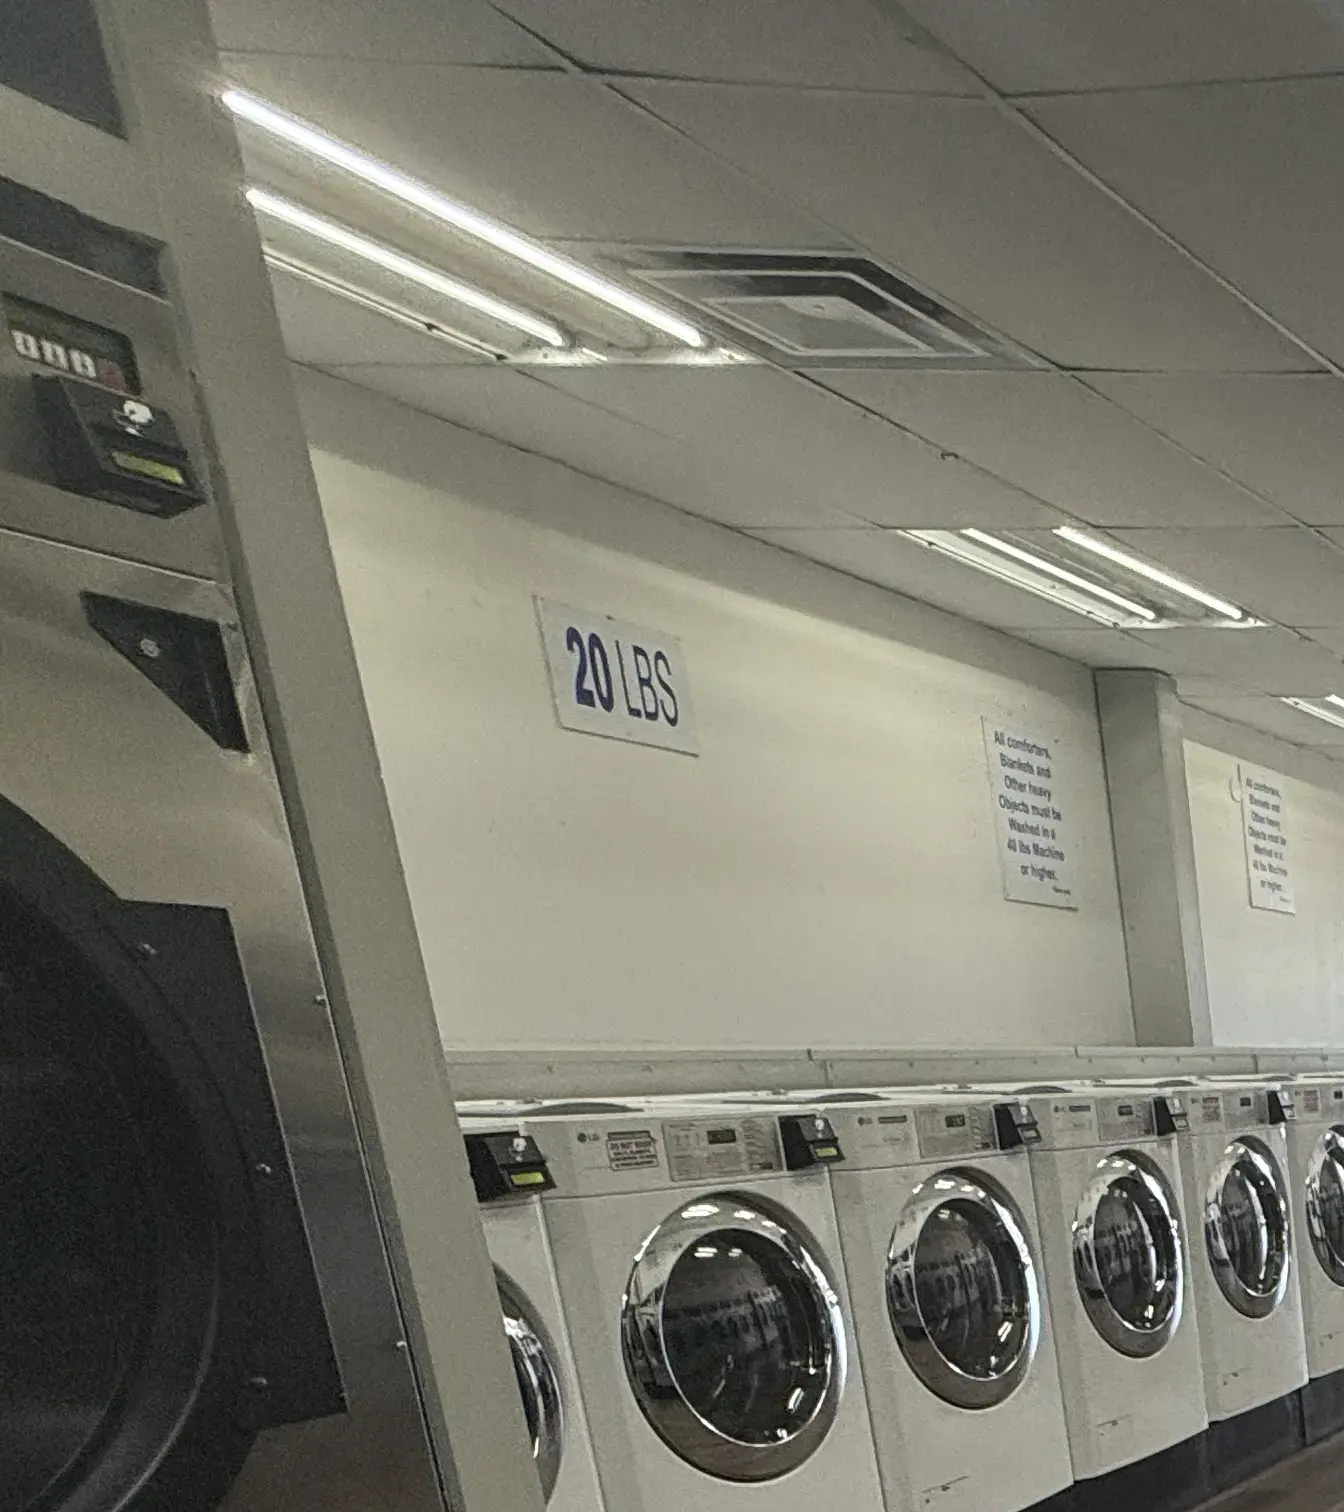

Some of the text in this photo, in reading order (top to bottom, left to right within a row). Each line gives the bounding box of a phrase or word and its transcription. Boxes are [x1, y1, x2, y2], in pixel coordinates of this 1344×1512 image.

[566, 626, 679, 728] 20 LBS
[994, 731, 1004, 746] All
[1000, 753, 1051, 779] Blankets and
[1004, 775, 1051, 802] Other heavy
[999, 794, 1062, 821] Objects must be
[1008, 817, 1056, 840] Washed in a
[1019, 840, 1031, 856] lbs
[1032, 843, 1065, 862] Machine
[1021, 864, 1029, 876] or
